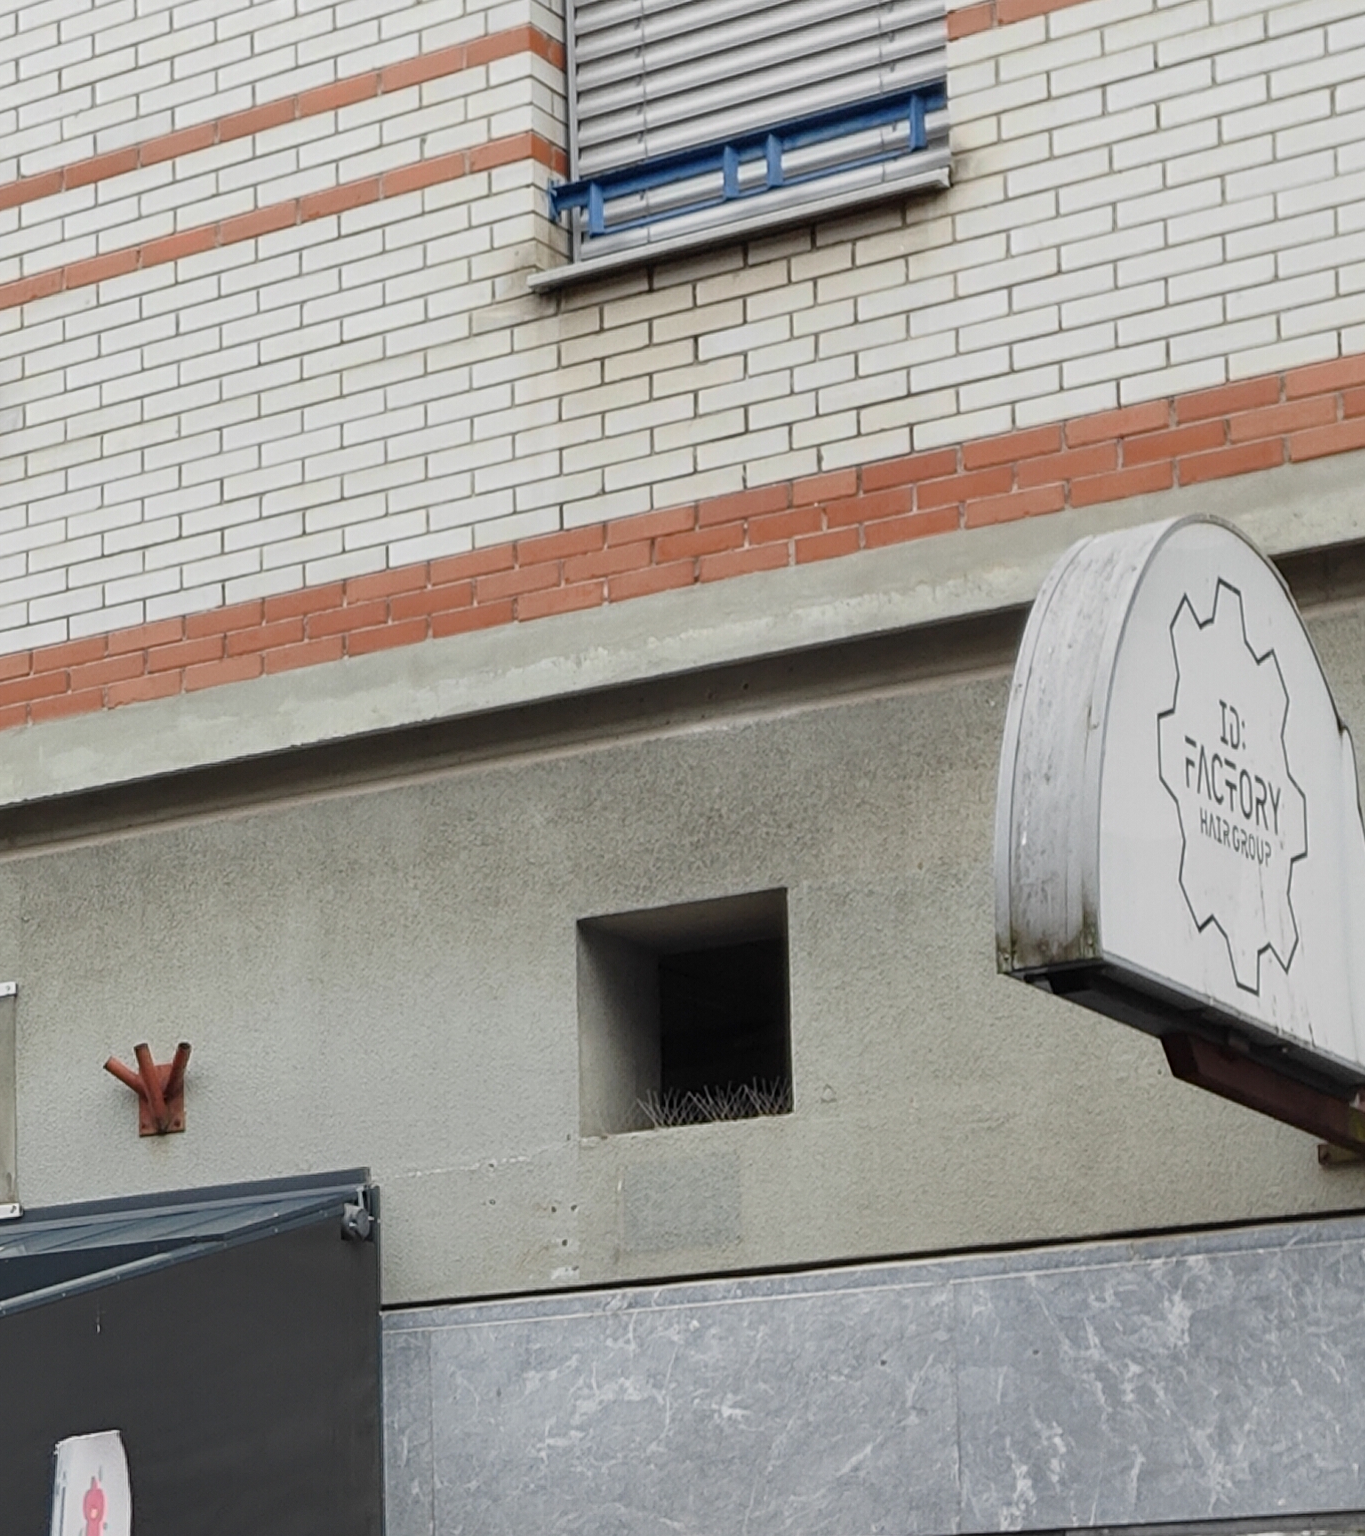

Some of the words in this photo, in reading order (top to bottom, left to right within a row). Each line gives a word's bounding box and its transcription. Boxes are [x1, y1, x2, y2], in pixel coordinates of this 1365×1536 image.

[1219, 699, 1246, 750] ID:
[1185, 735, 1281, 836] FACTORY
[1200, 807, 1230, 848] HAIR
[1232, 825, 1272, 867] GROUP
